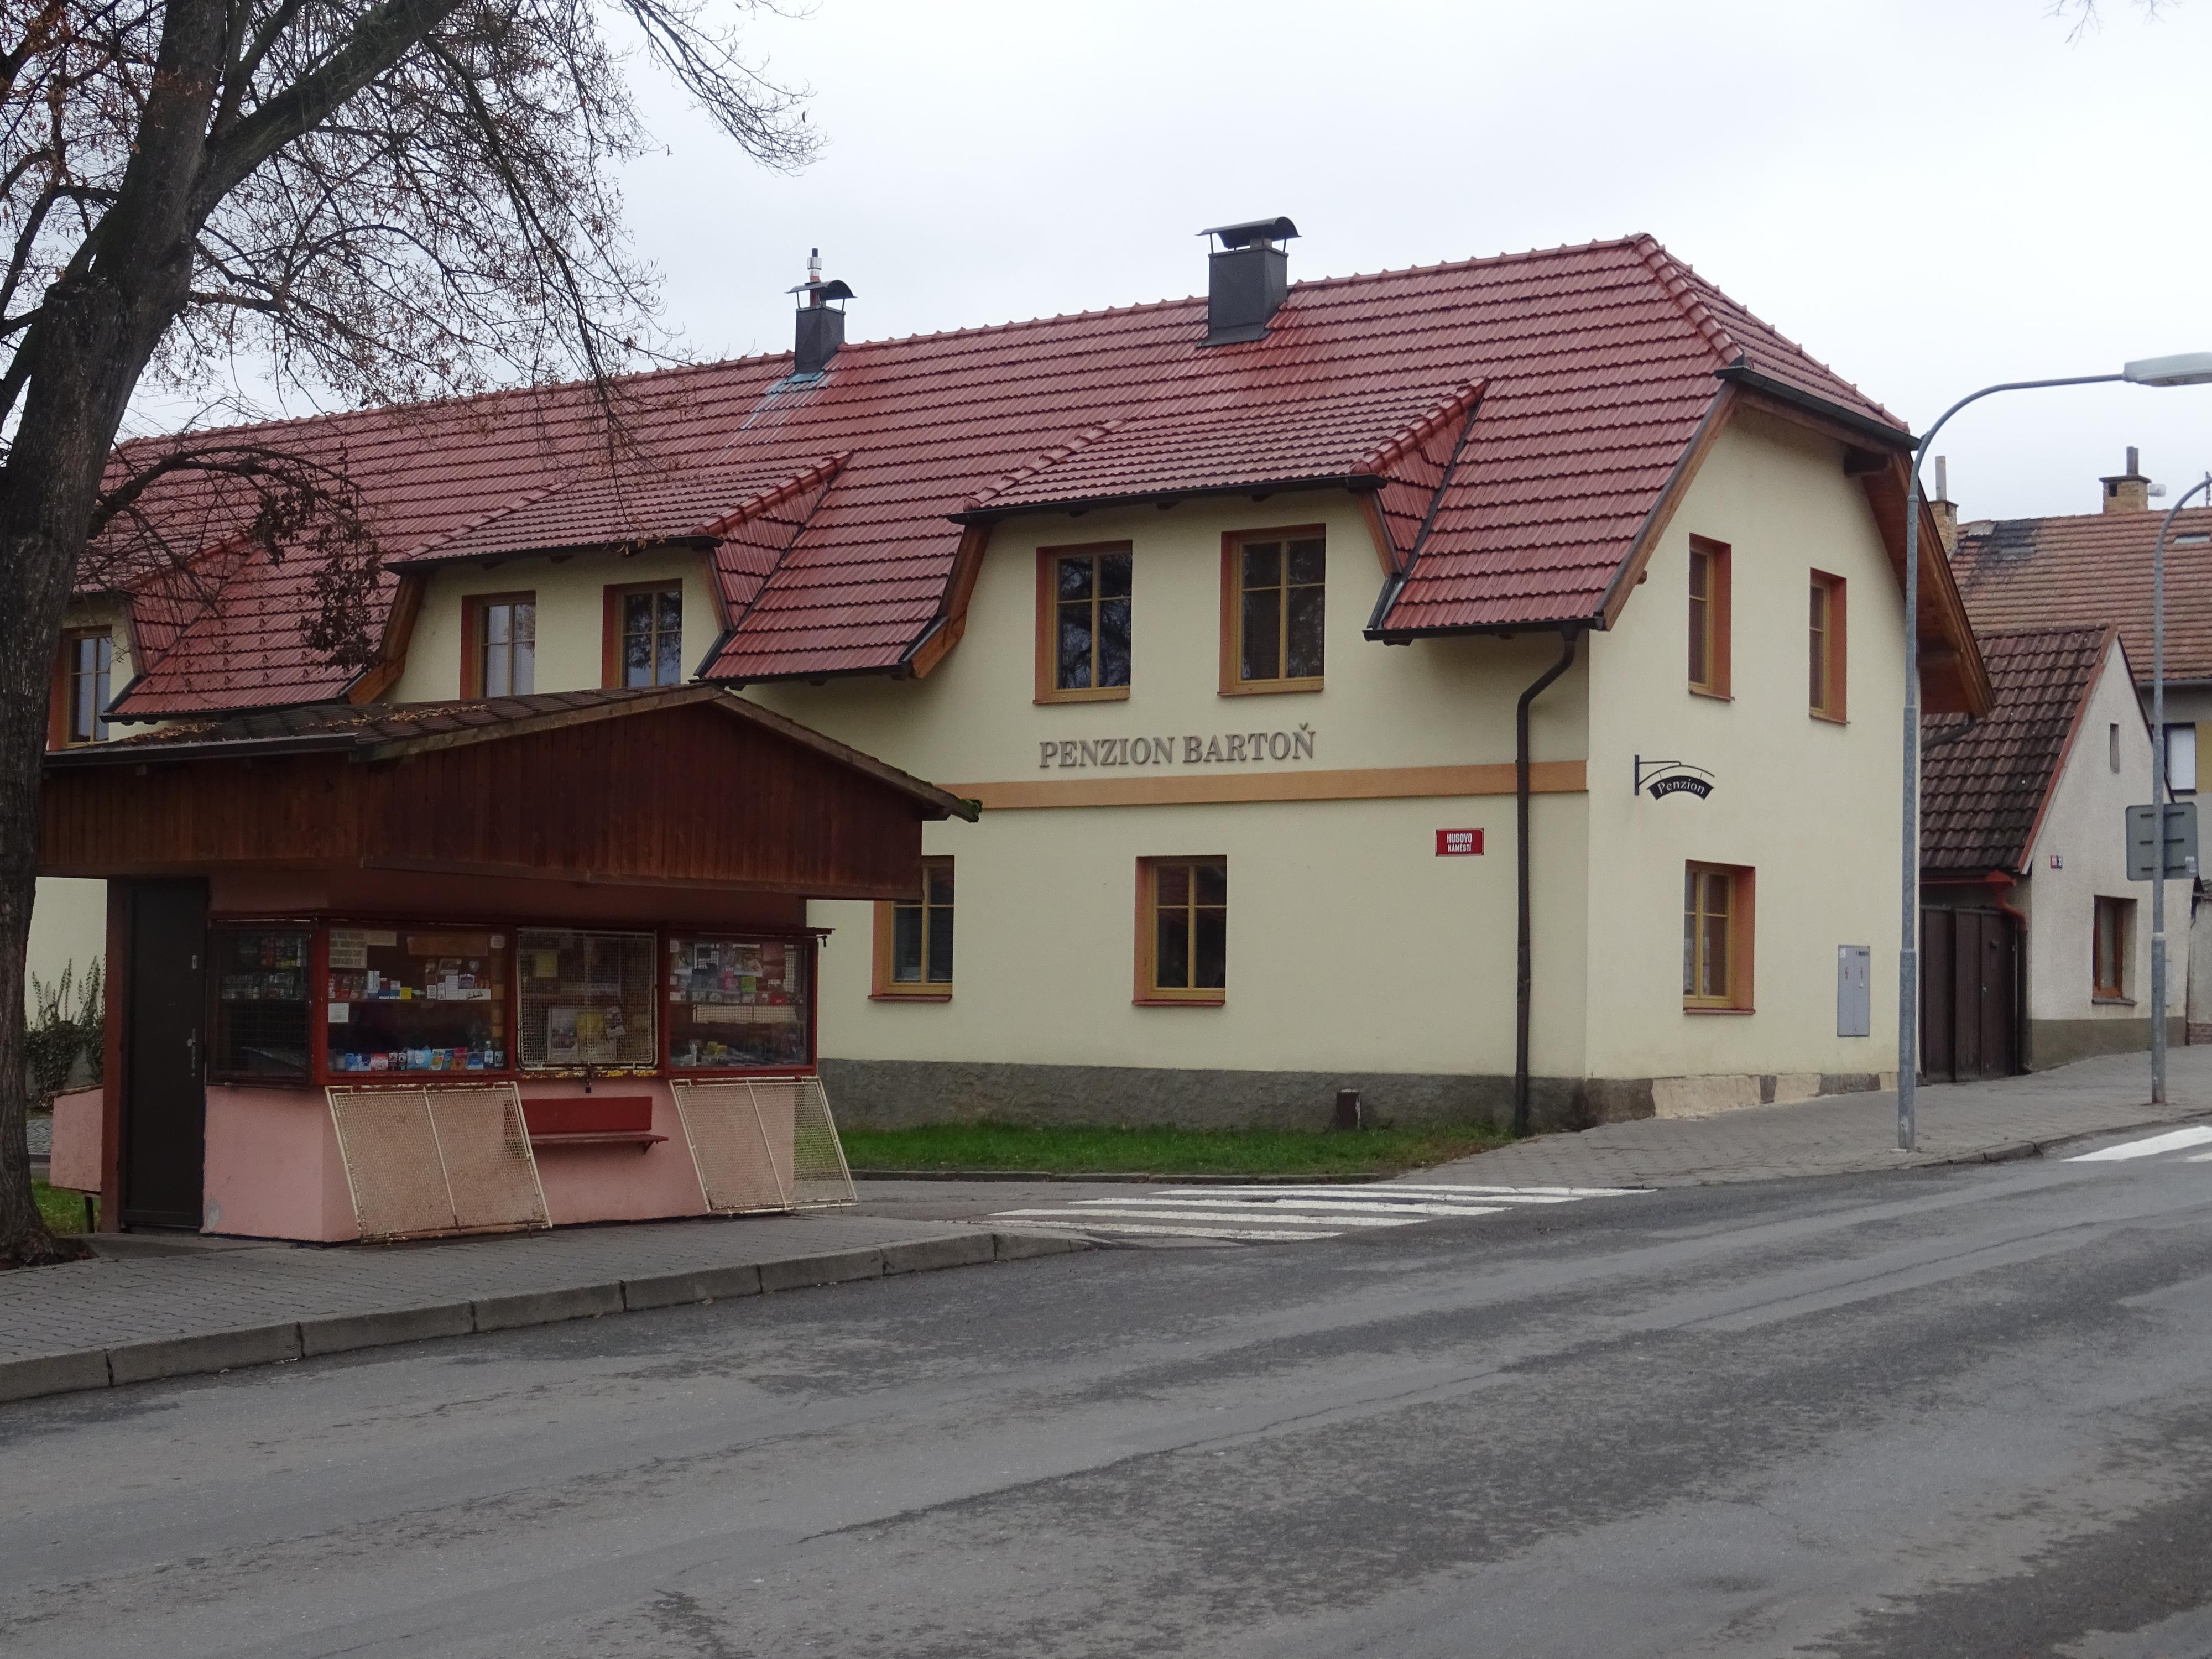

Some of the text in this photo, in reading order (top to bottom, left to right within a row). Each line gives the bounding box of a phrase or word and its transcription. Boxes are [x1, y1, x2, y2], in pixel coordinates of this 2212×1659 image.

[1039, 722, 1316, 768] PENZION BARTOŇ
[1657, 779, 1705, 794] Penzion
[1447, 833, 1473, 843] HUSOVO
[1448, 843, 1472, 852] NÁMĚSTÍ
